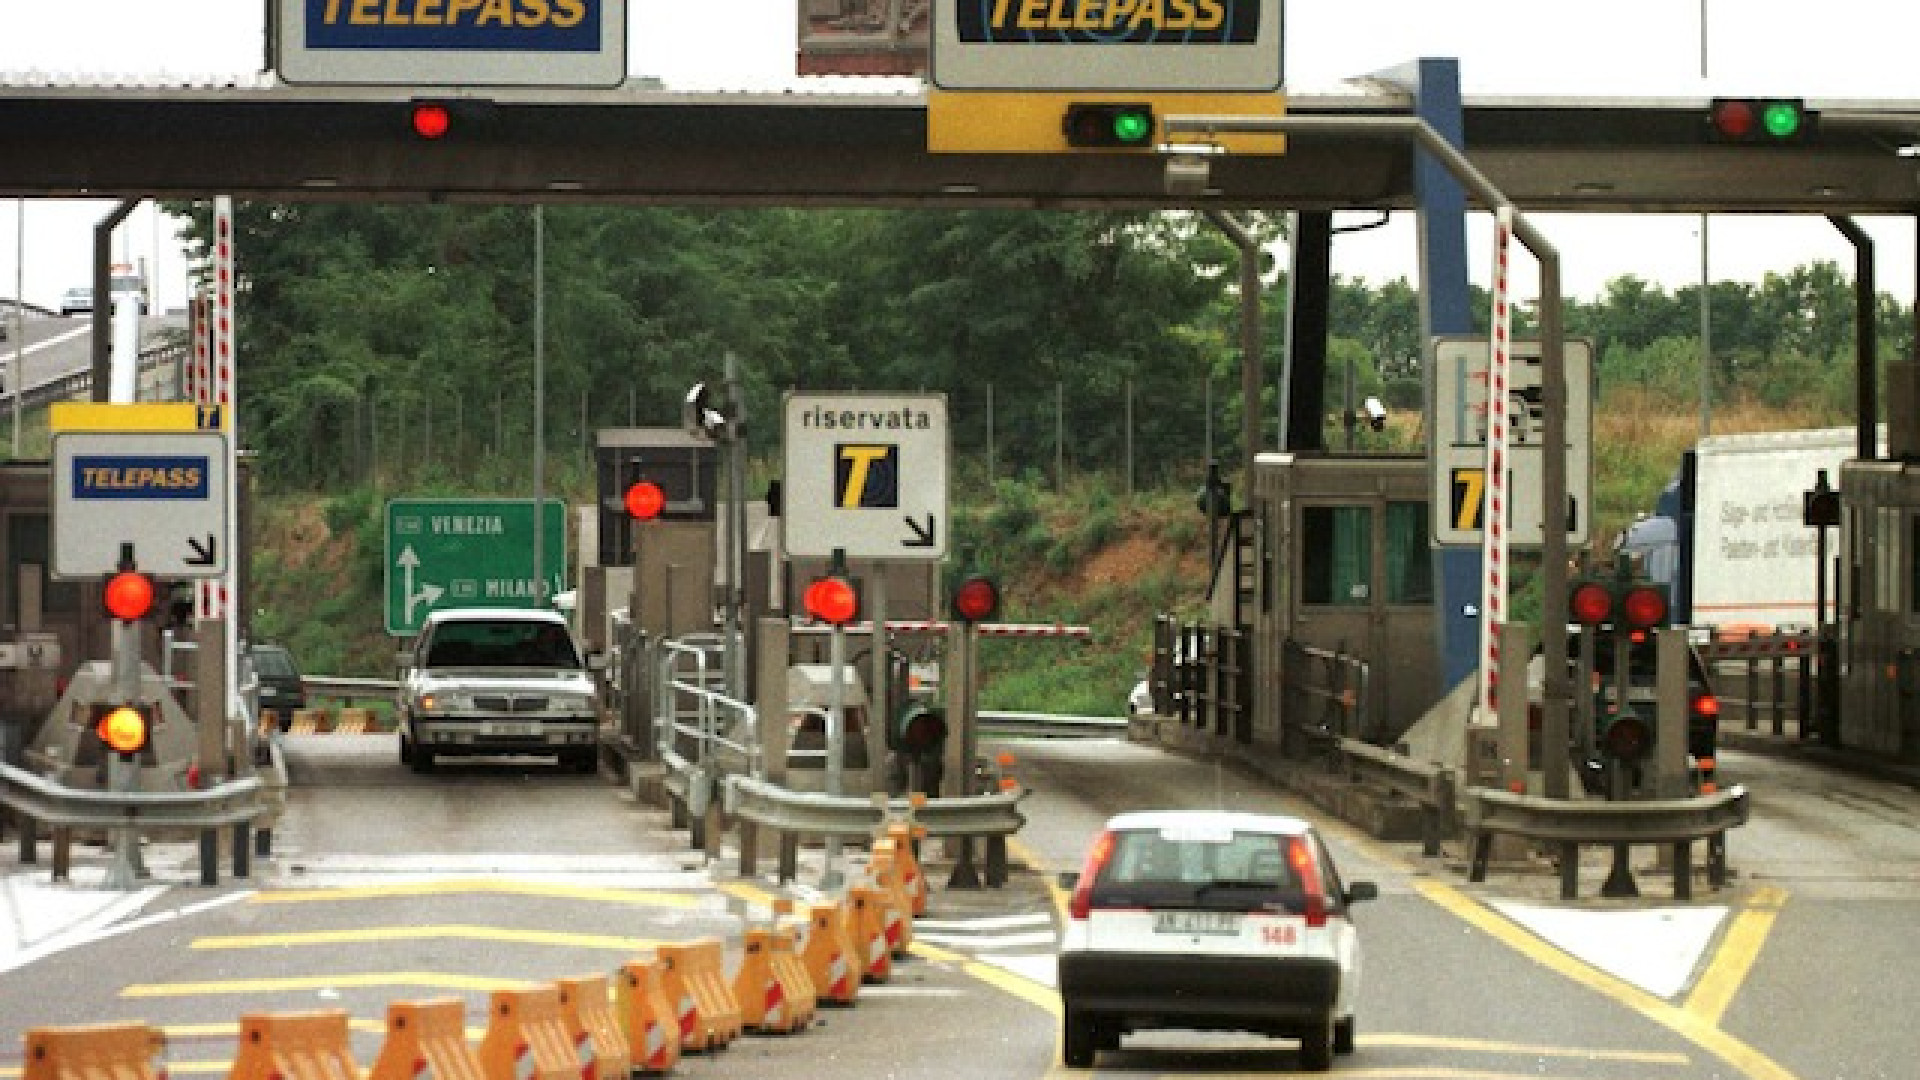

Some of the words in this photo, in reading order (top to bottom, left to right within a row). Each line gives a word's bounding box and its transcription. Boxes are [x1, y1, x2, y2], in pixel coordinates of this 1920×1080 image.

[322, 0, 587, 28] TELEPASS
[991, 0, 1226, 29] TELEPASS
[802, 405, 931, 430] riservata
[81, 466, 201, 489] TELEPASS
[839, 445, 889, 510] T
[430, 515, 504, 535] VENEZIA
[485, 578, 550, 598] MILANO
[1260, 925, 1297, 946] 148
